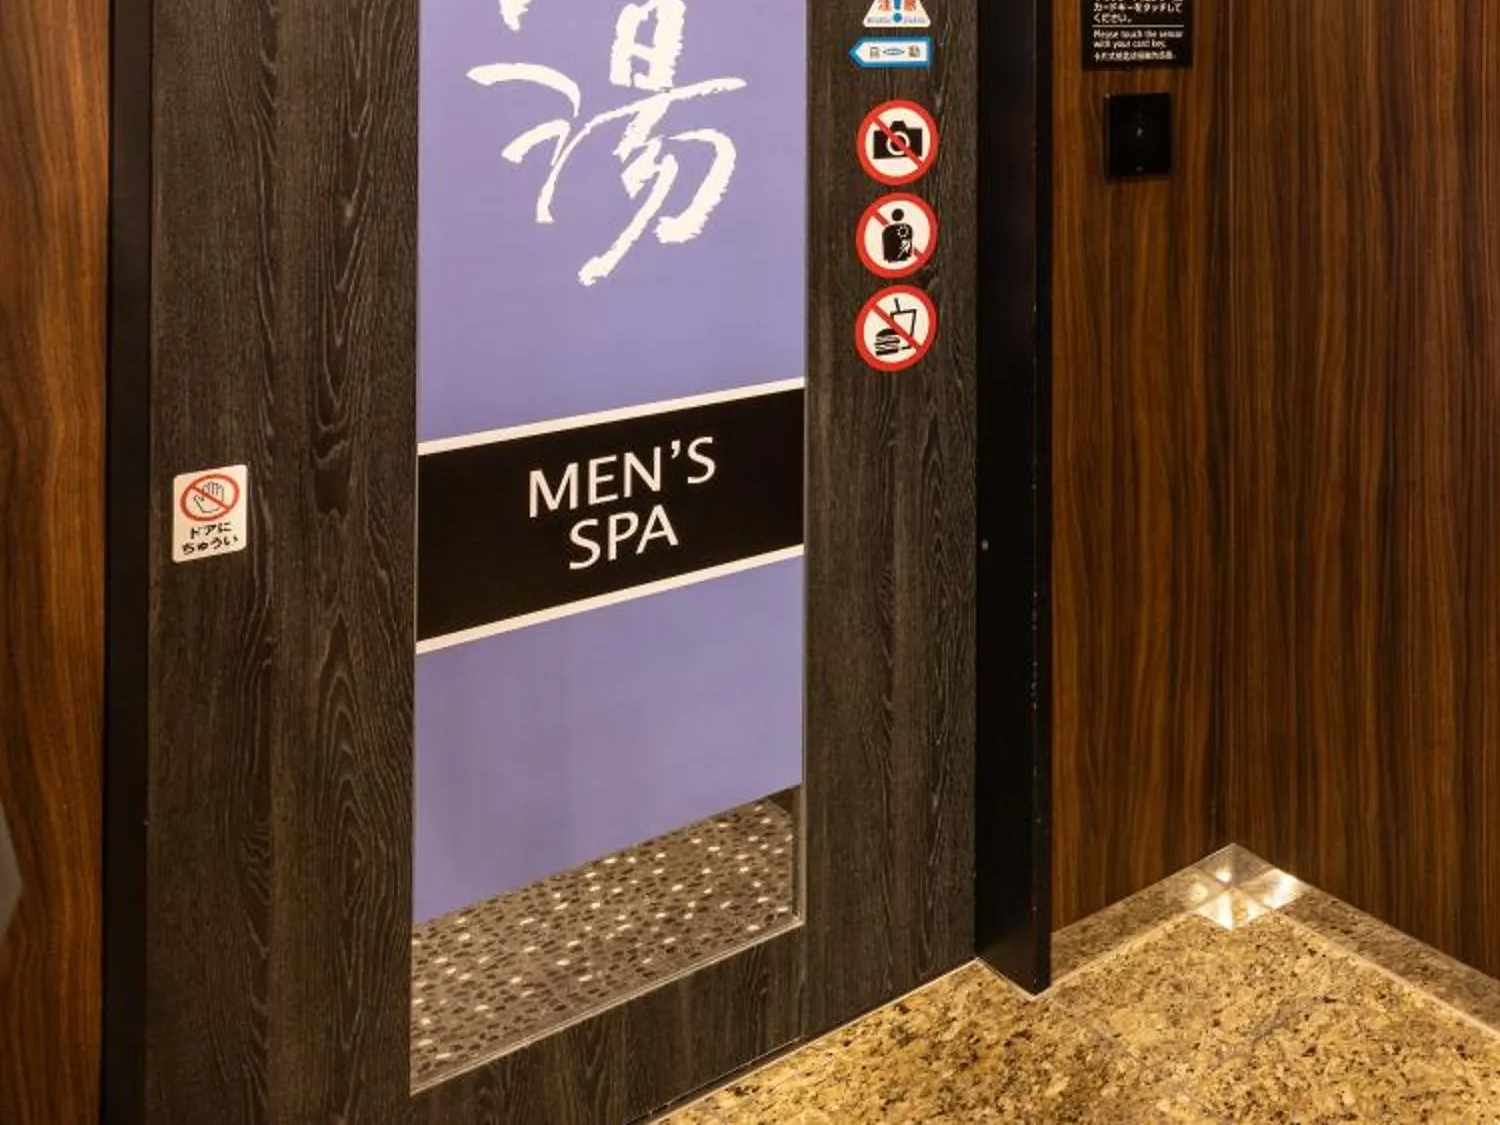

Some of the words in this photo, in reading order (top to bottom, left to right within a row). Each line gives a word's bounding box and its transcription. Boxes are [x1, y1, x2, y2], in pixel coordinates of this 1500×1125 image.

[528, 436, 716, 518] MEN'S
[182, 535, 239, 555] ちゅうい
[190, 522, 232, 540] ドアに
[569, 504, 679, 570] SPA
